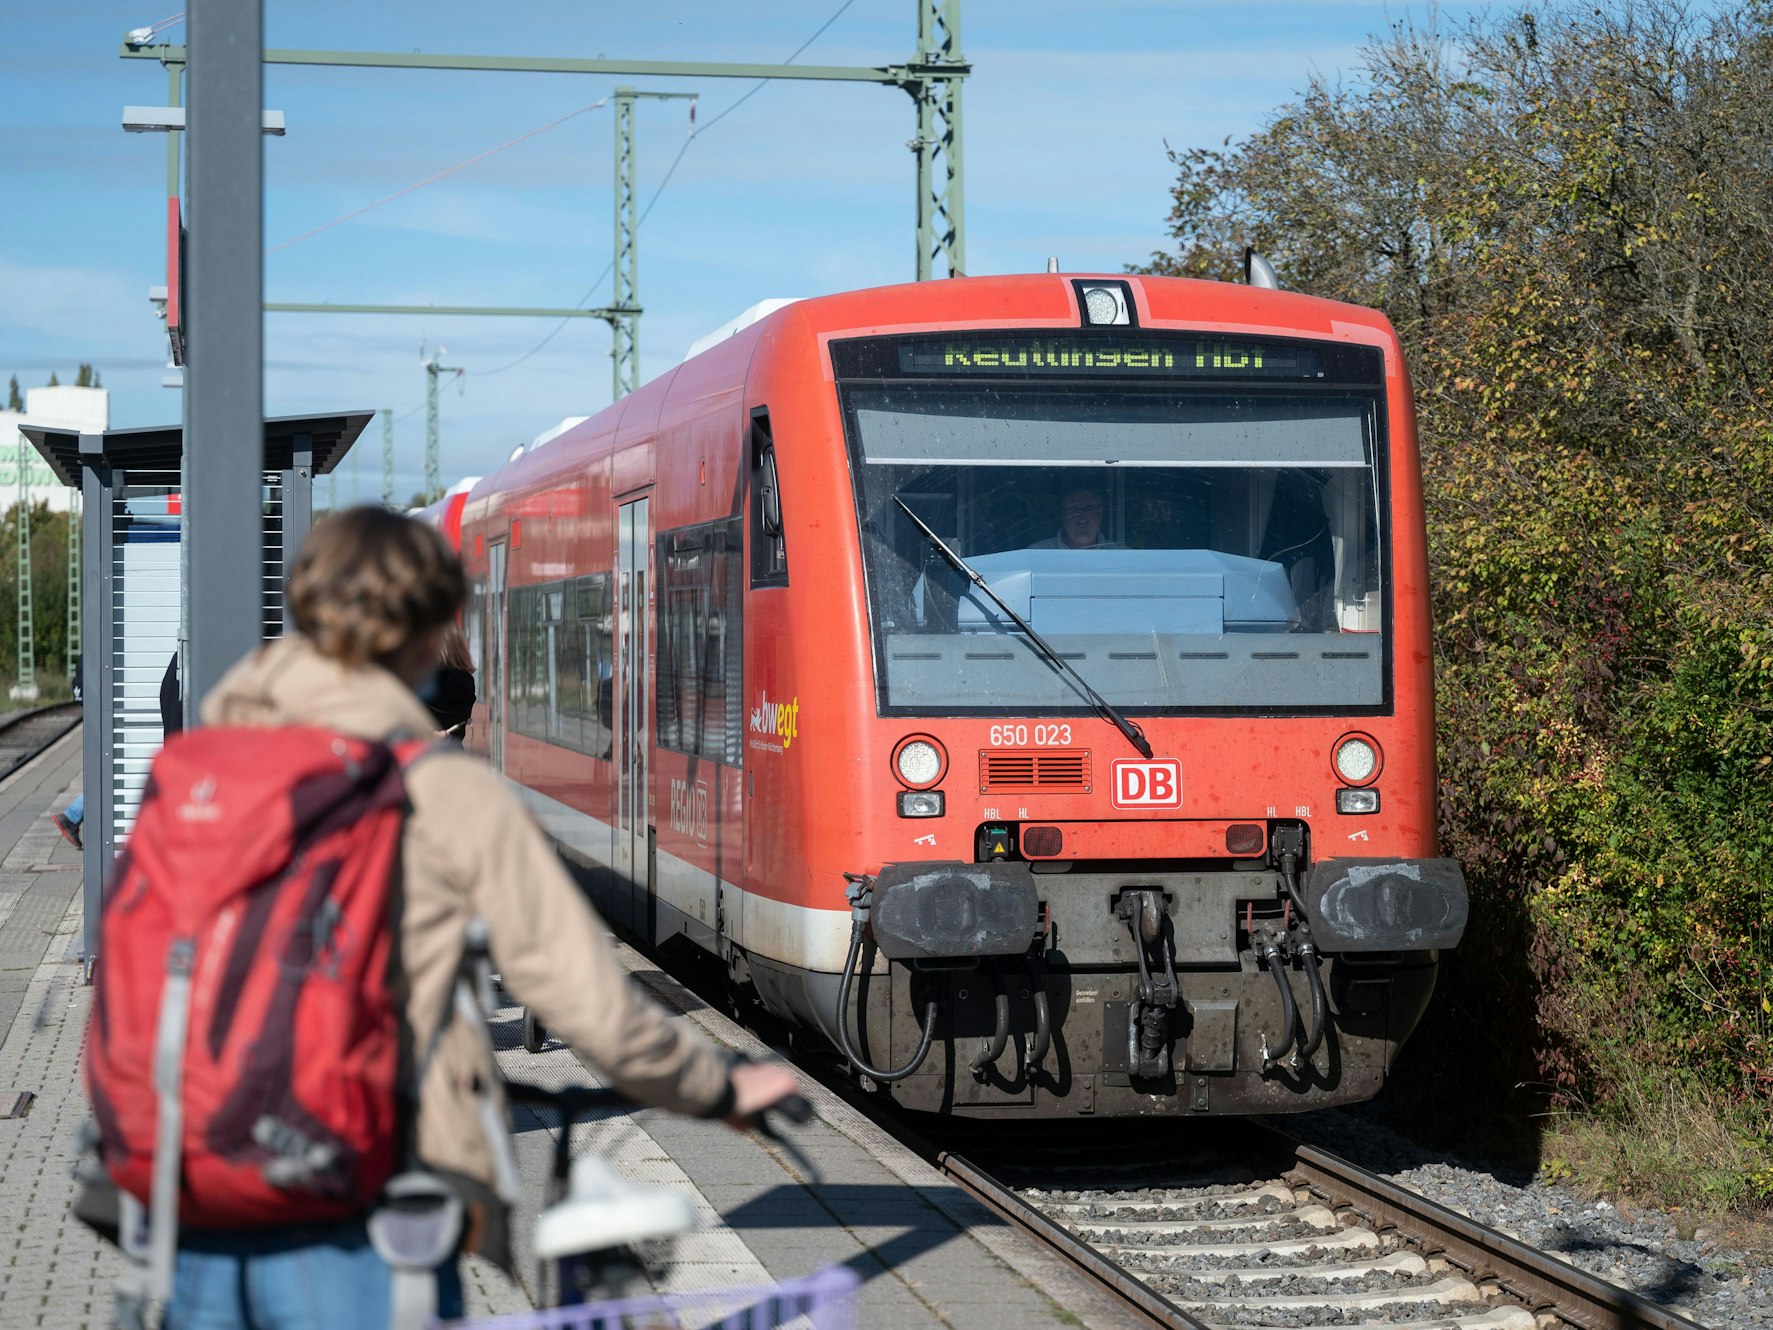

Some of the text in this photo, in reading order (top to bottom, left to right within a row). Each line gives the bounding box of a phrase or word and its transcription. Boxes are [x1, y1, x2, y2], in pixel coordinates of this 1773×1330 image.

[762, 689, 799, 749] bwegt
[990, 724, 1072, 746] 650 023
[1121, 767, 1174, 800] DB
[670, 778, 696, 838] REGIO
[984, 807, 1030, 820] HBL HL
[1266, 805, 1312, 818] HL HBL
